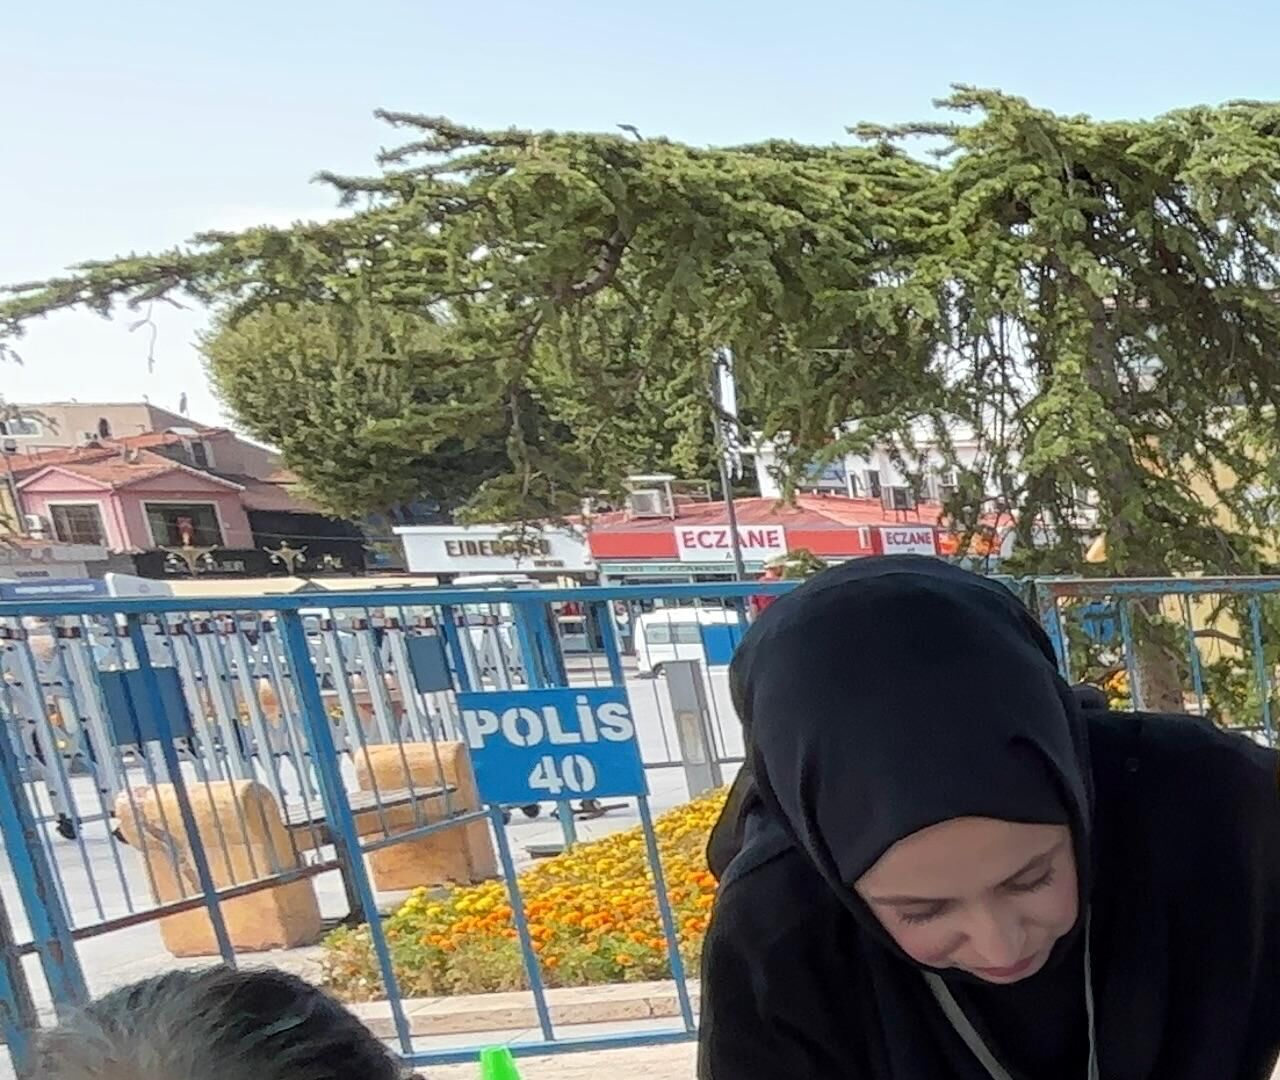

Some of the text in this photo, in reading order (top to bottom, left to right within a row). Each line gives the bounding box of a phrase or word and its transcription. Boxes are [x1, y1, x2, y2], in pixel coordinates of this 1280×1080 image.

[683, 528, 781, 549] ECZANE
[886, 531, 932, 546] ECZANE
[462, 695, 634, 749] POLİS
[528, 754, 596, 794] 40
